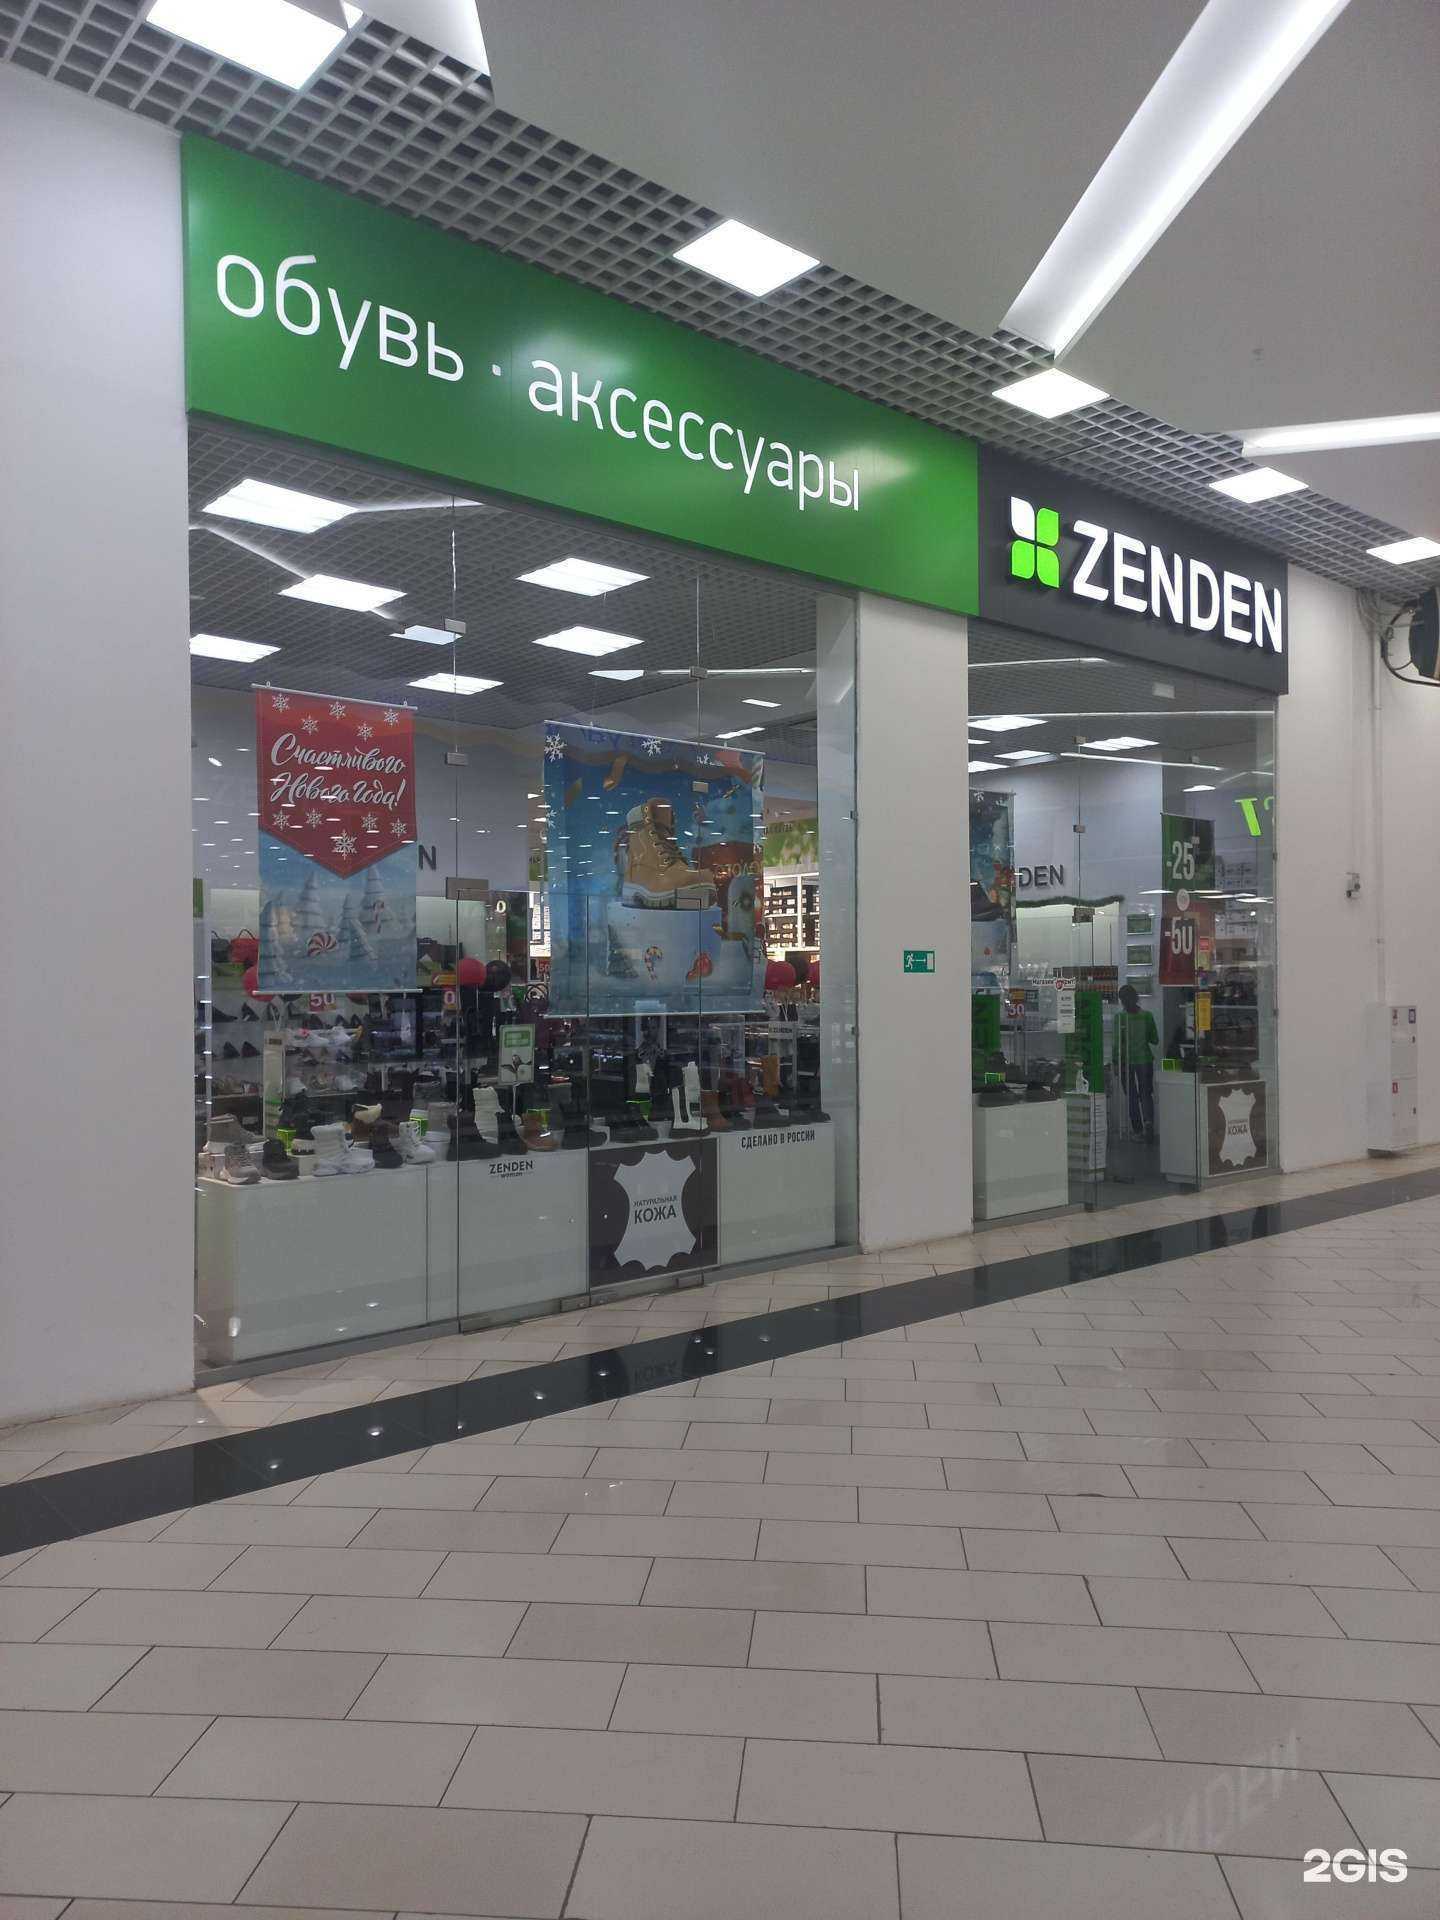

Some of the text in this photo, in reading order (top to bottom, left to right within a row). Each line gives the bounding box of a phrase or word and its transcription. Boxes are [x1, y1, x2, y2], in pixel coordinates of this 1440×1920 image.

[216, 253, 860, 512] обувь аксессуары
[1072, 519, 1283, 654] ZENDEN
[271, 732, 406, 774] Счастливого
[741, 1132, 778, 1150] СДЕЛАНО
[787, 1129, 815, 1144] РОССИИ
[489, 1160, 533, 1175] ZENDEN
[634, 1204, 677, 1224] КОЖА
